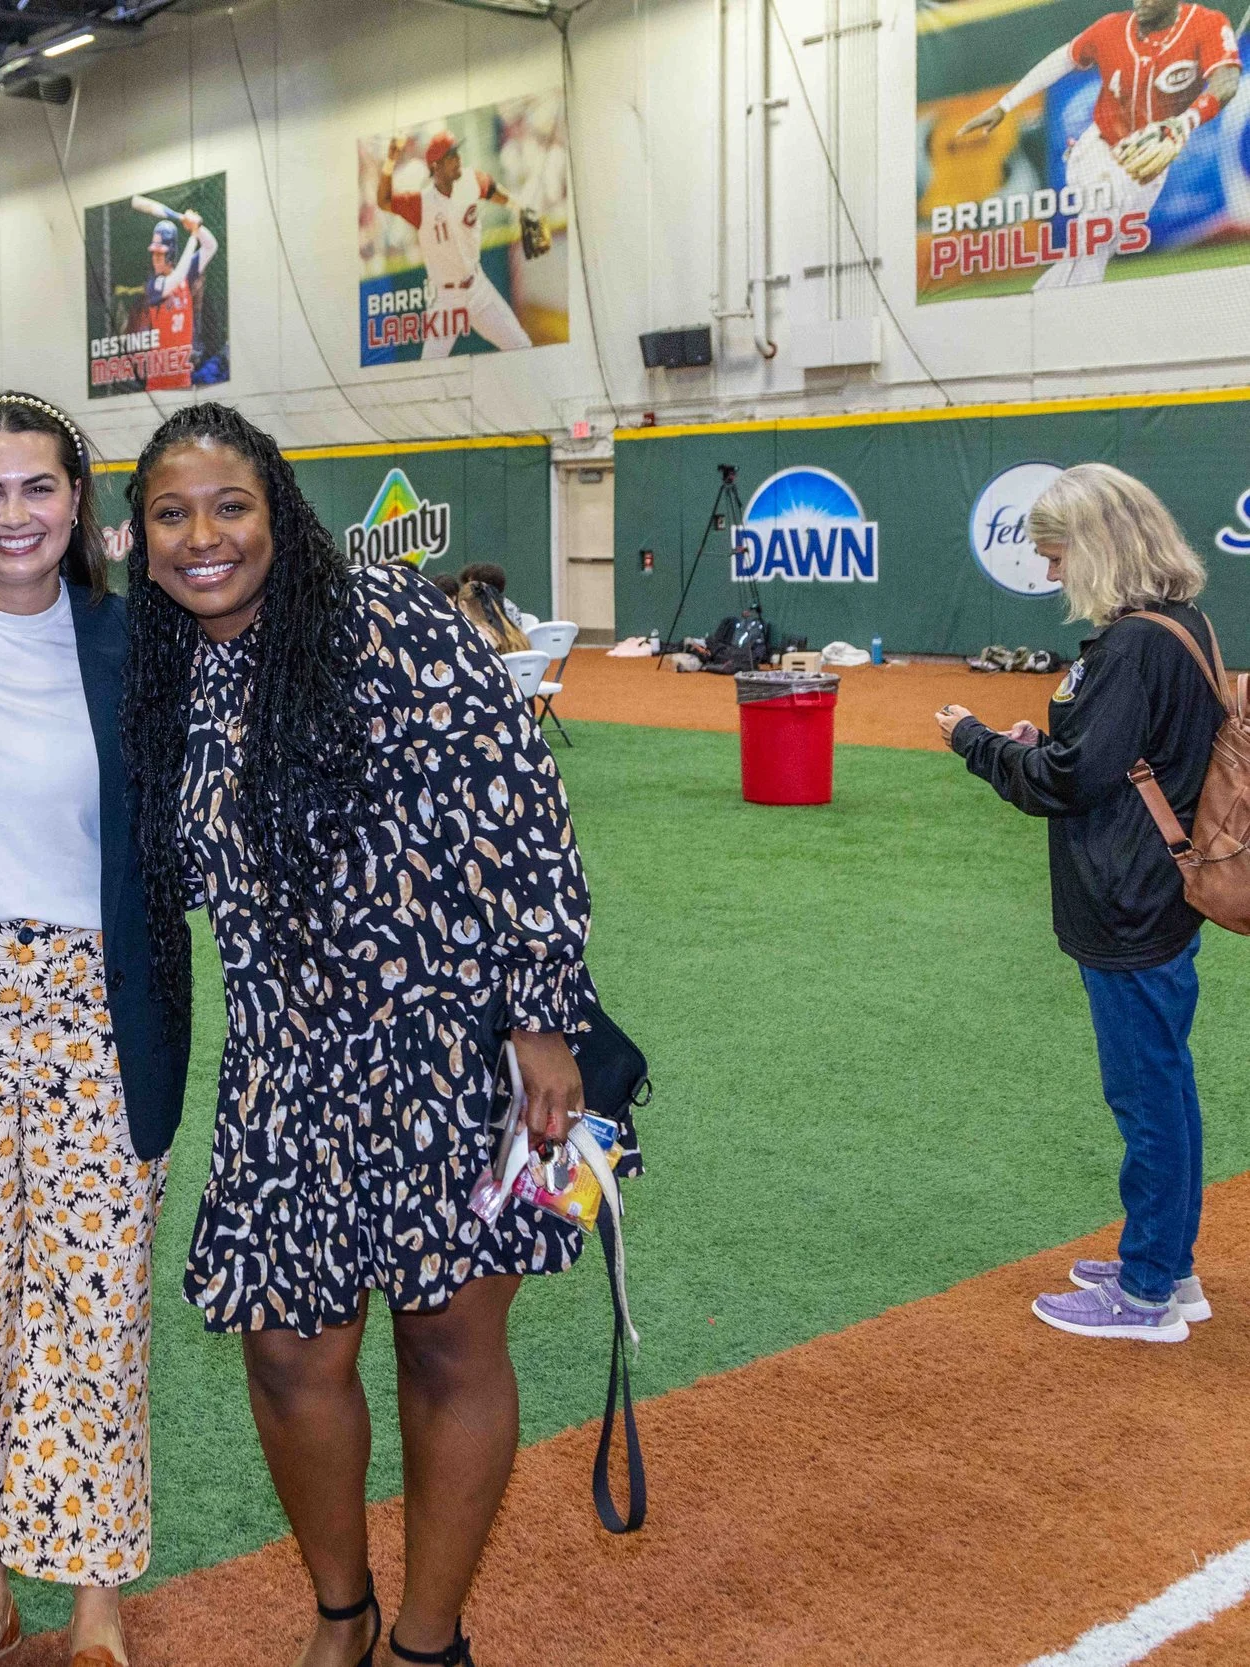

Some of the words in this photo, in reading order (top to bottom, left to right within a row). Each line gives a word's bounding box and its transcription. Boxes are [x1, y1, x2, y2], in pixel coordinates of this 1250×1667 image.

[931, 183, 1113, 235] BRANDON
[931, 210, 1151, 279] PHILLIPS
[367, 283, 437, 317] BARRY
[91, 329, 160, 358] DESTINEE
[368, 307, 470, 349] LARKIN
[91, 344, 194, 385] MARTINEZ
[346, 500, 449, 567] Bounty
[735, 526, 874, 577] DAWN
